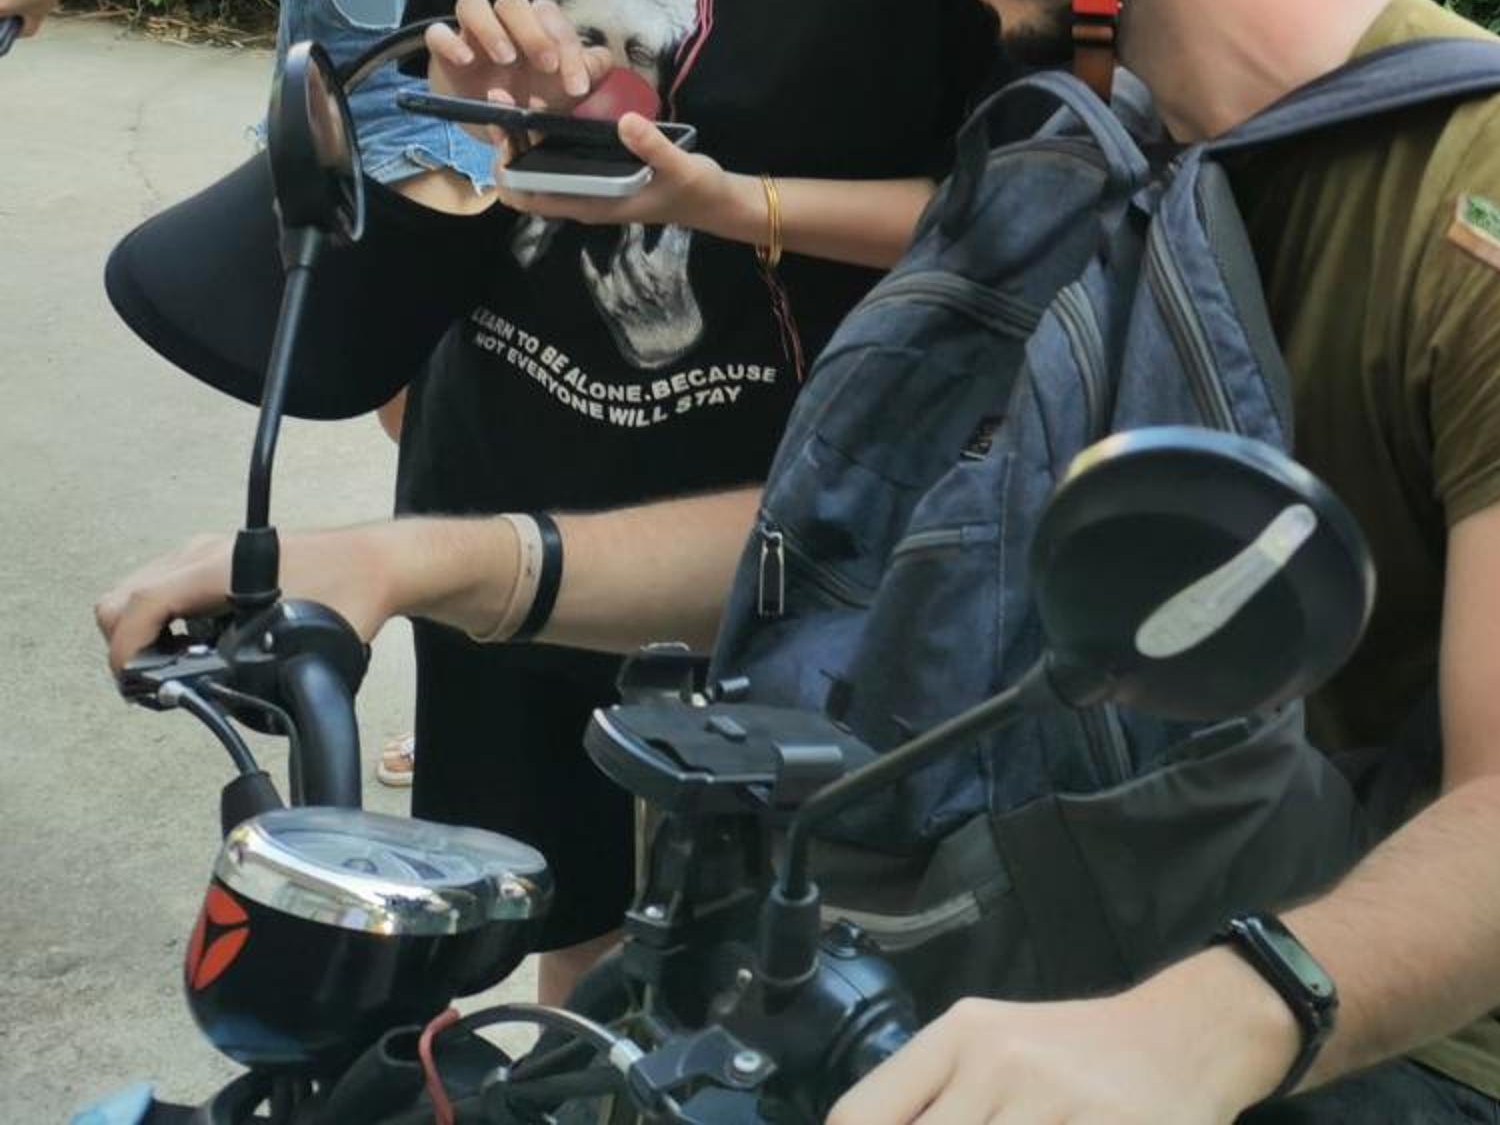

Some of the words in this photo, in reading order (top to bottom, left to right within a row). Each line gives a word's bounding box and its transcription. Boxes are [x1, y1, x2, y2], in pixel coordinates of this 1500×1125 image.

[471, 306, 515, 341] LEARN
[517, 330, 540, 354] TO
[540, 345, 570, 374] BE
[474, 332, 507, 355] NOT
[506, 347, 604, 420] EVERYONE
[608, 405, 669, 428] WILL
[674, 384, 742, 414] STAY
